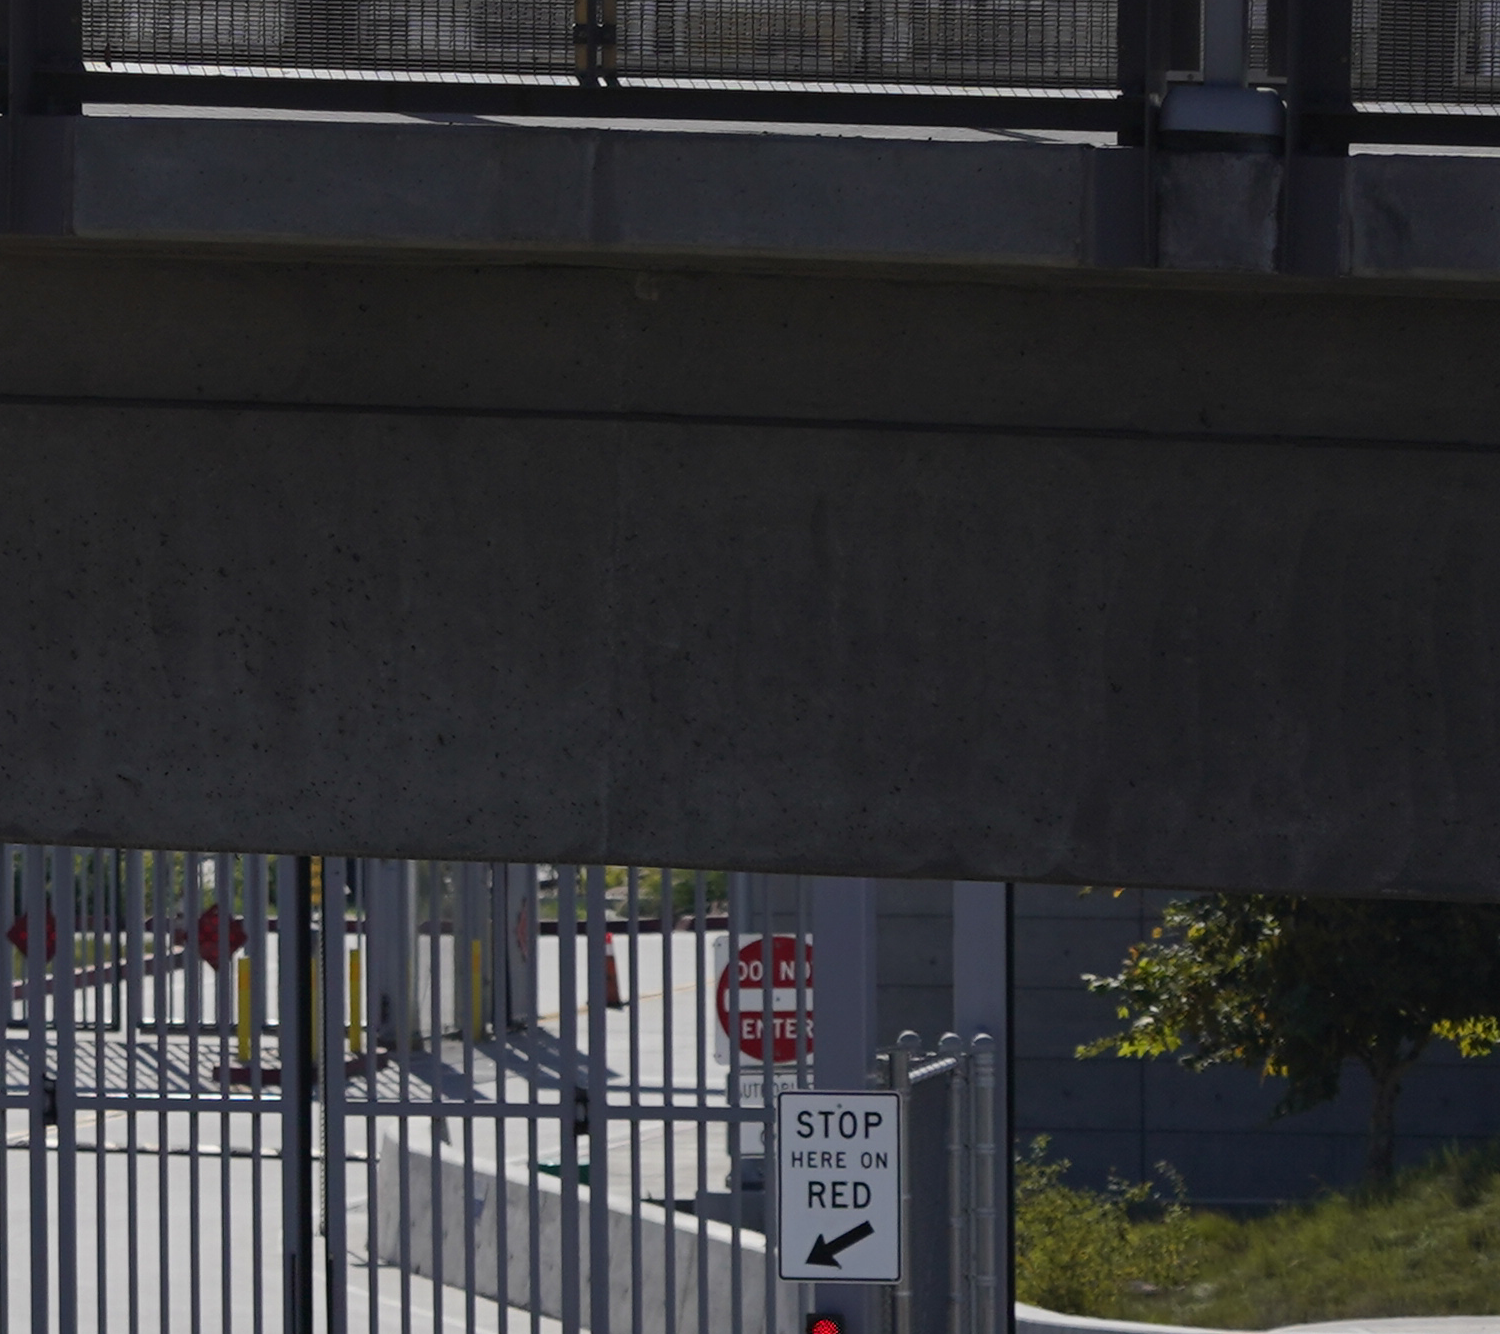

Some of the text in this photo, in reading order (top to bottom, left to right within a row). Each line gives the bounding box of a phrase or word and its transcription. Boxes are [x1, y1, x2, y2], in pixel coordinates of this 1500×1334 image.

[796, 1110, 883, 1139] STOP
[791, 1151, 888, 1169] HERE ON
[808, 1180, 872, 1209] RED
